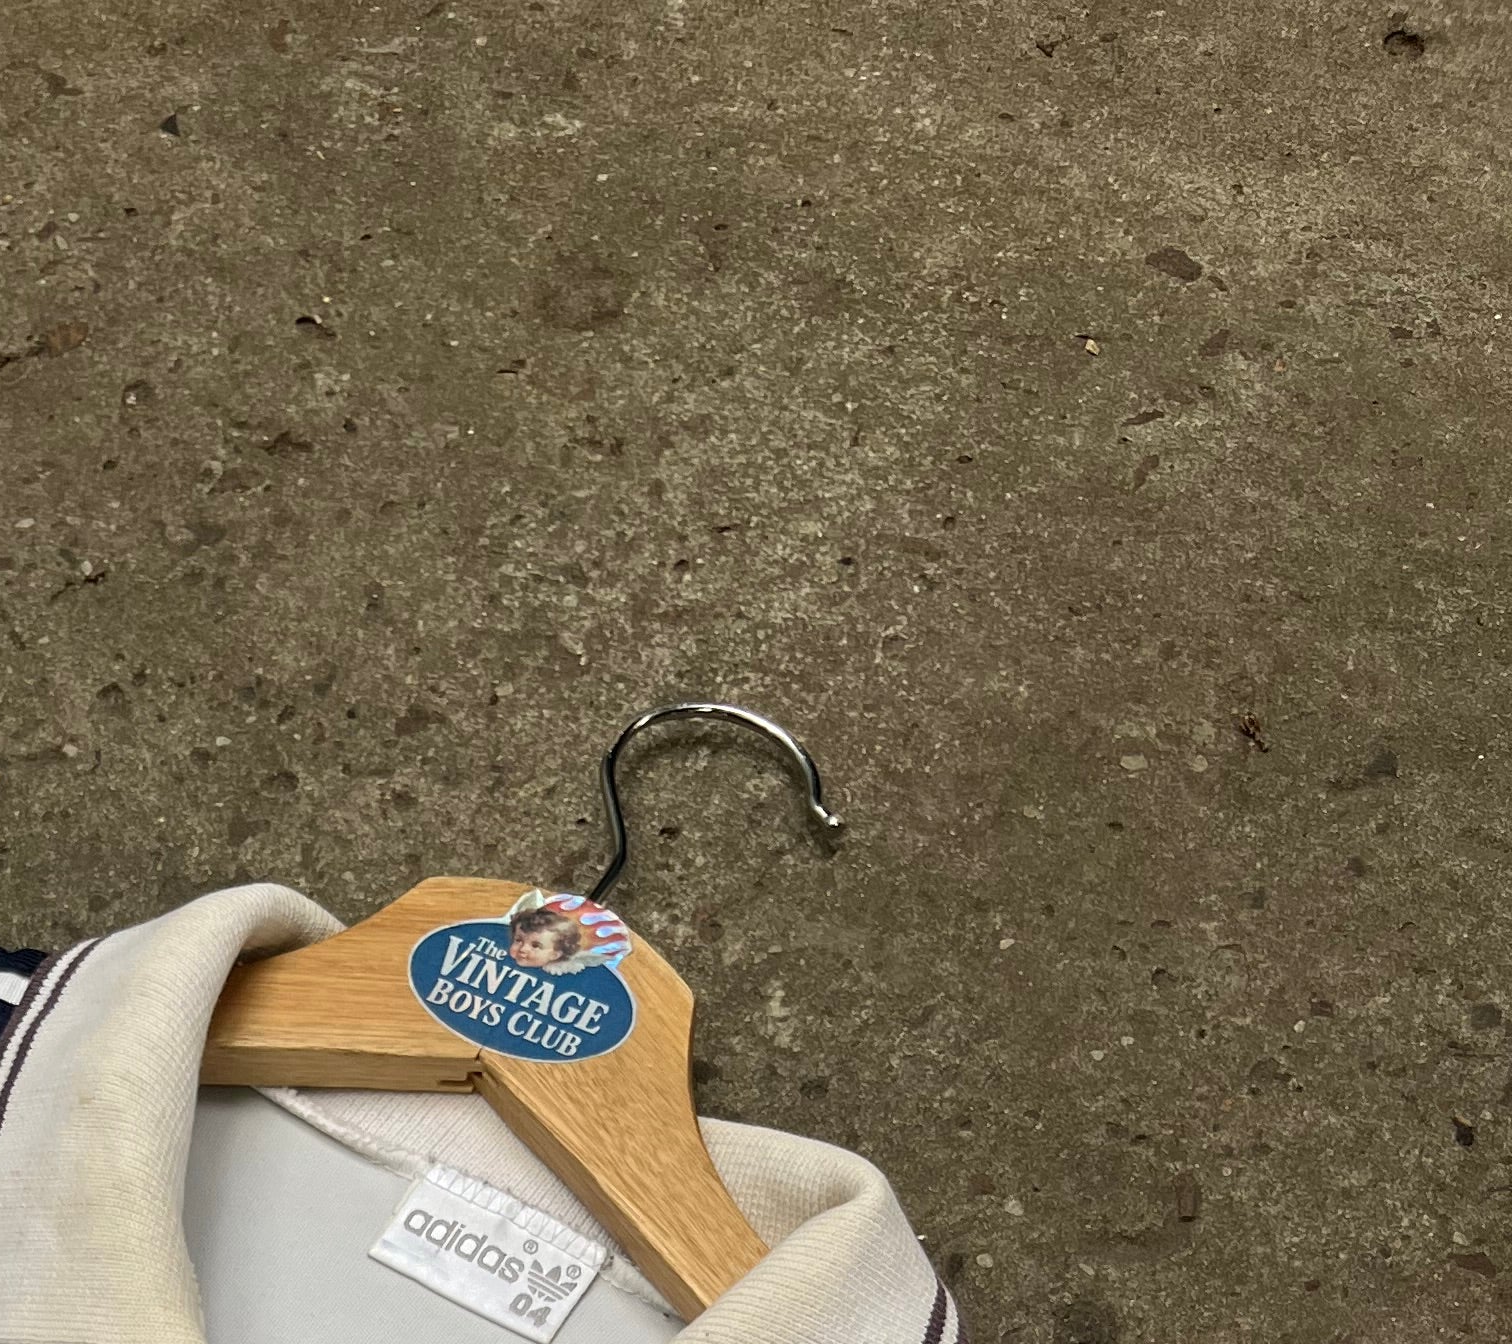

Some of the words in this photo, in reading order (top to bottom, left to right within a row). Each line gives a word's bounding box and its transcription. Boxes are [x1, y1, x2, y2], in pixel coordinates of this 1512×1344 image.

[438, 935, 610, 1035] VINTAGE
[475, 936, 508, 962] The
[426, 978, 505, 1027] BOYS
[507, 1011, 583, 1058] CLUB
[403, 1209, 525, 1284] adidas
